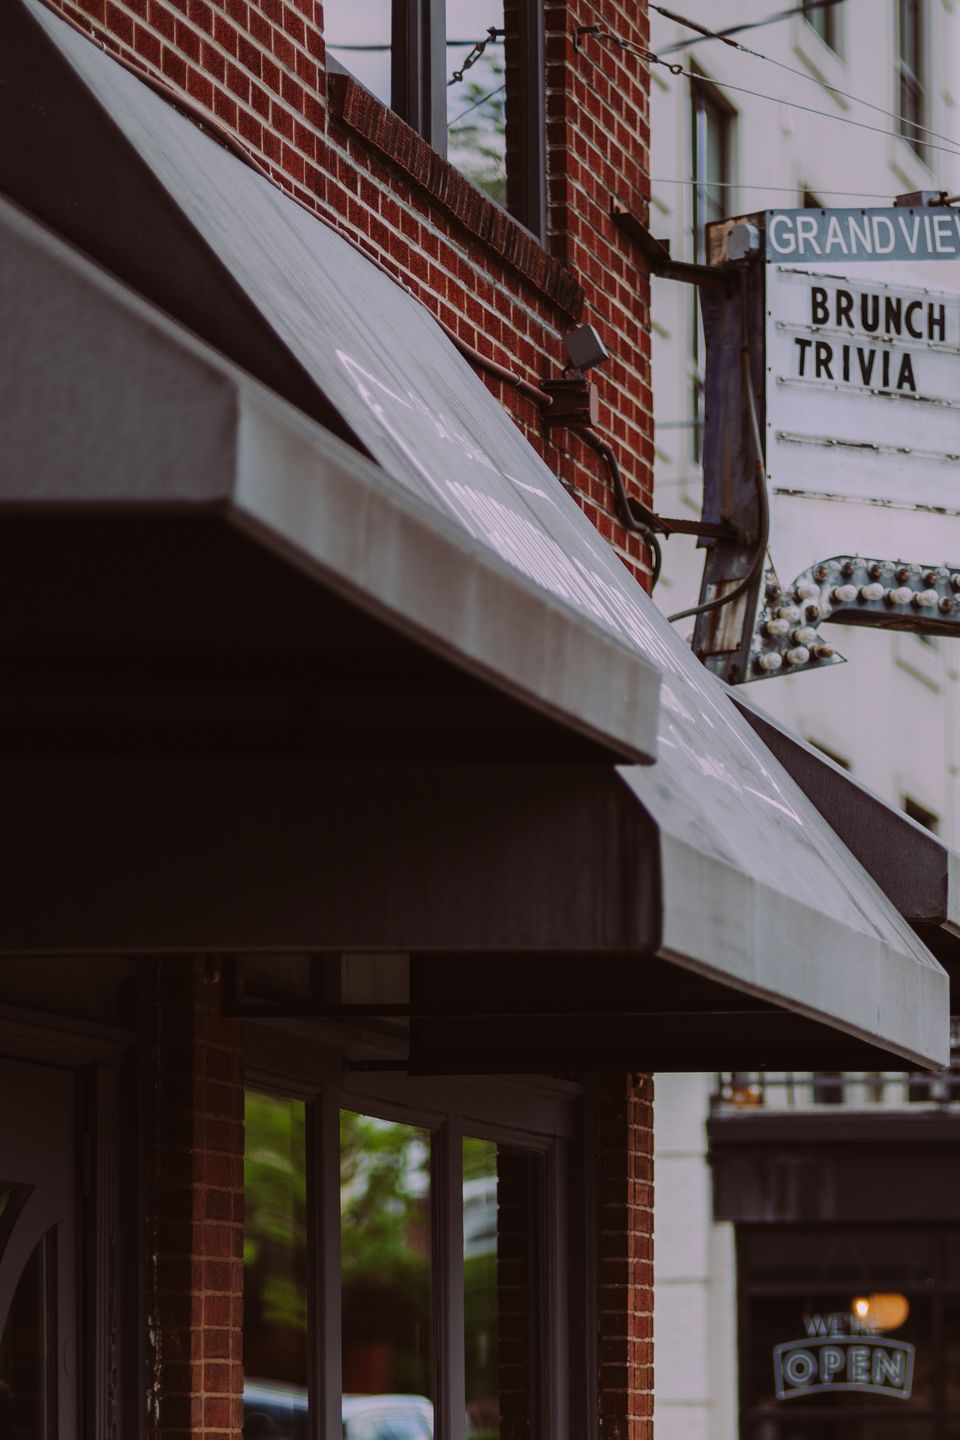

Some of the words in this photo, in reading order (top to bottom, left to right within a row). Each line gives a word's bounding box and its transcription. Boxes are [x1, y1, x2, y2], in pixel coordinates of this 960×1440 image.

[811, 286, 946, 341] BRUNCH
[794, 337, 917, 392] TRIVIA
[783, 1345, 907, 1387] OPEN
